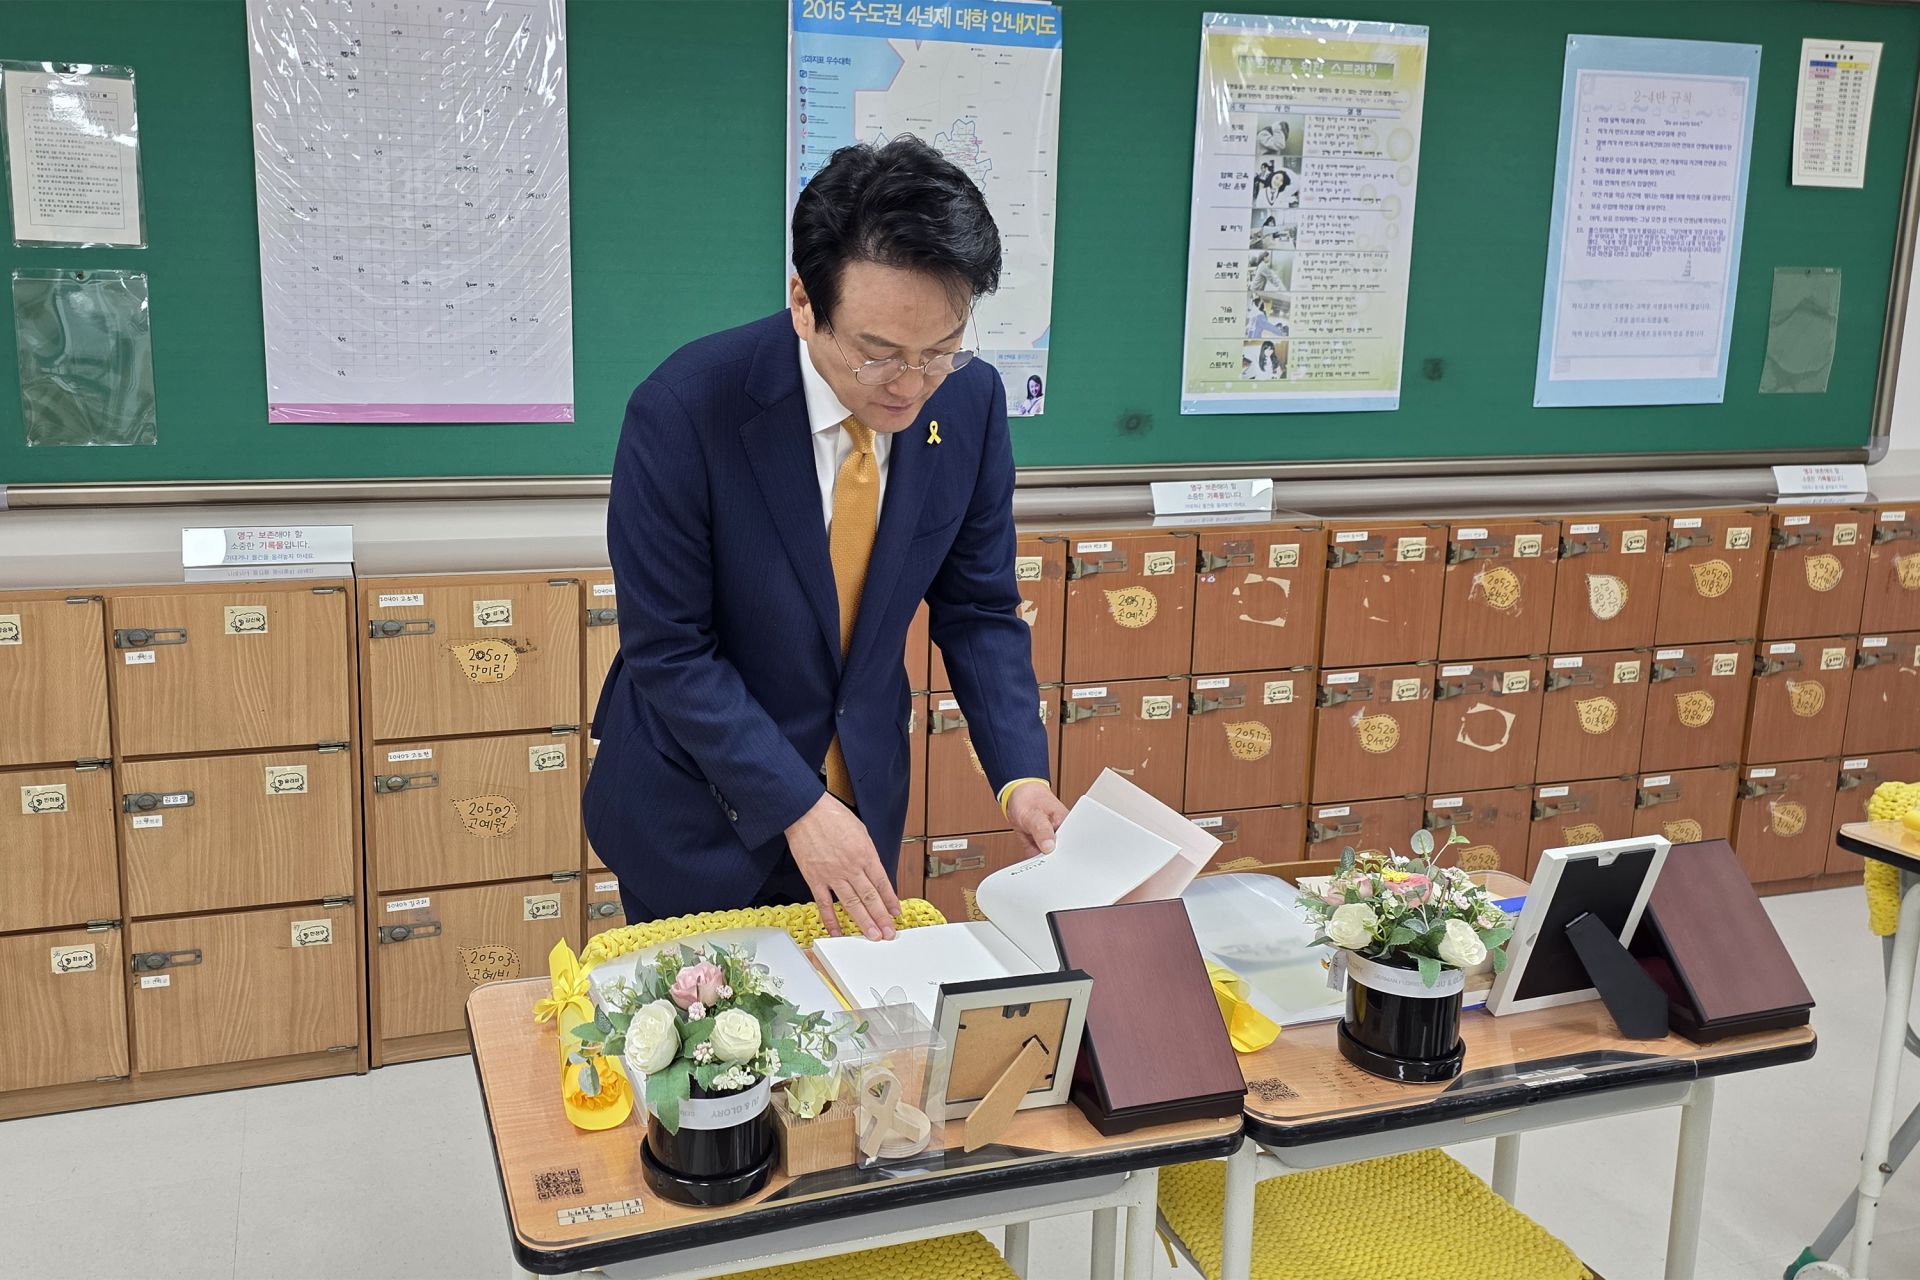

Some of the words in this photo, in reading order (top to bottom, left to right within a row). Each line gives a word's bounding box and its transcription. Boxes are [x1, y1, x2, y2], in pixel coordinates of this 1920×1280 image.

[802, 0, 845, 21] 2015
[848, 2, 902, 25] 수도권
[905, 5, 951, 29] 4년제
[955, 9, 988, 32] 대학
[990, 11, 1057, 36] 안내지도
[825, 55, 852, 66] 우수대학
[1331, 63, 1378, 78] 스트레칭
[1671, 91, 1693, 106] 규칙
[1214, 271, 1240, 280] 스트레칭
[1212, 316, 1238, 324] 스트레칭
[1209, 360, 1235, 370] 스트레칭
[237, 531, 255, 540] 영구
[258, 530, 291, 540] 보존해야
[294, 529, 303, 539] 할
[231, 542, 255, 551] 소중한
[259, 540, 310, 550] 기록물입니다.
[251, 553, 269, 561] 물건을
[1699, 566, 1729, 581] 20529
[1487, 574, 1516, 596] 20522
[1116, 609, 1149, 623] 손예진
[468, 648, 509, 664] 20501
[469, 664, 507, 679] 강미림
[1235, 727, 1267, 742] 20517
[1364, 720, 1395, 735] 20520
[468, 802, 511, 819] 20502
[468, 818, 507, 834] 고예원
[1465, 852, 1497, 866] 20526
[710, 1105, 743, 1119] GLORY
